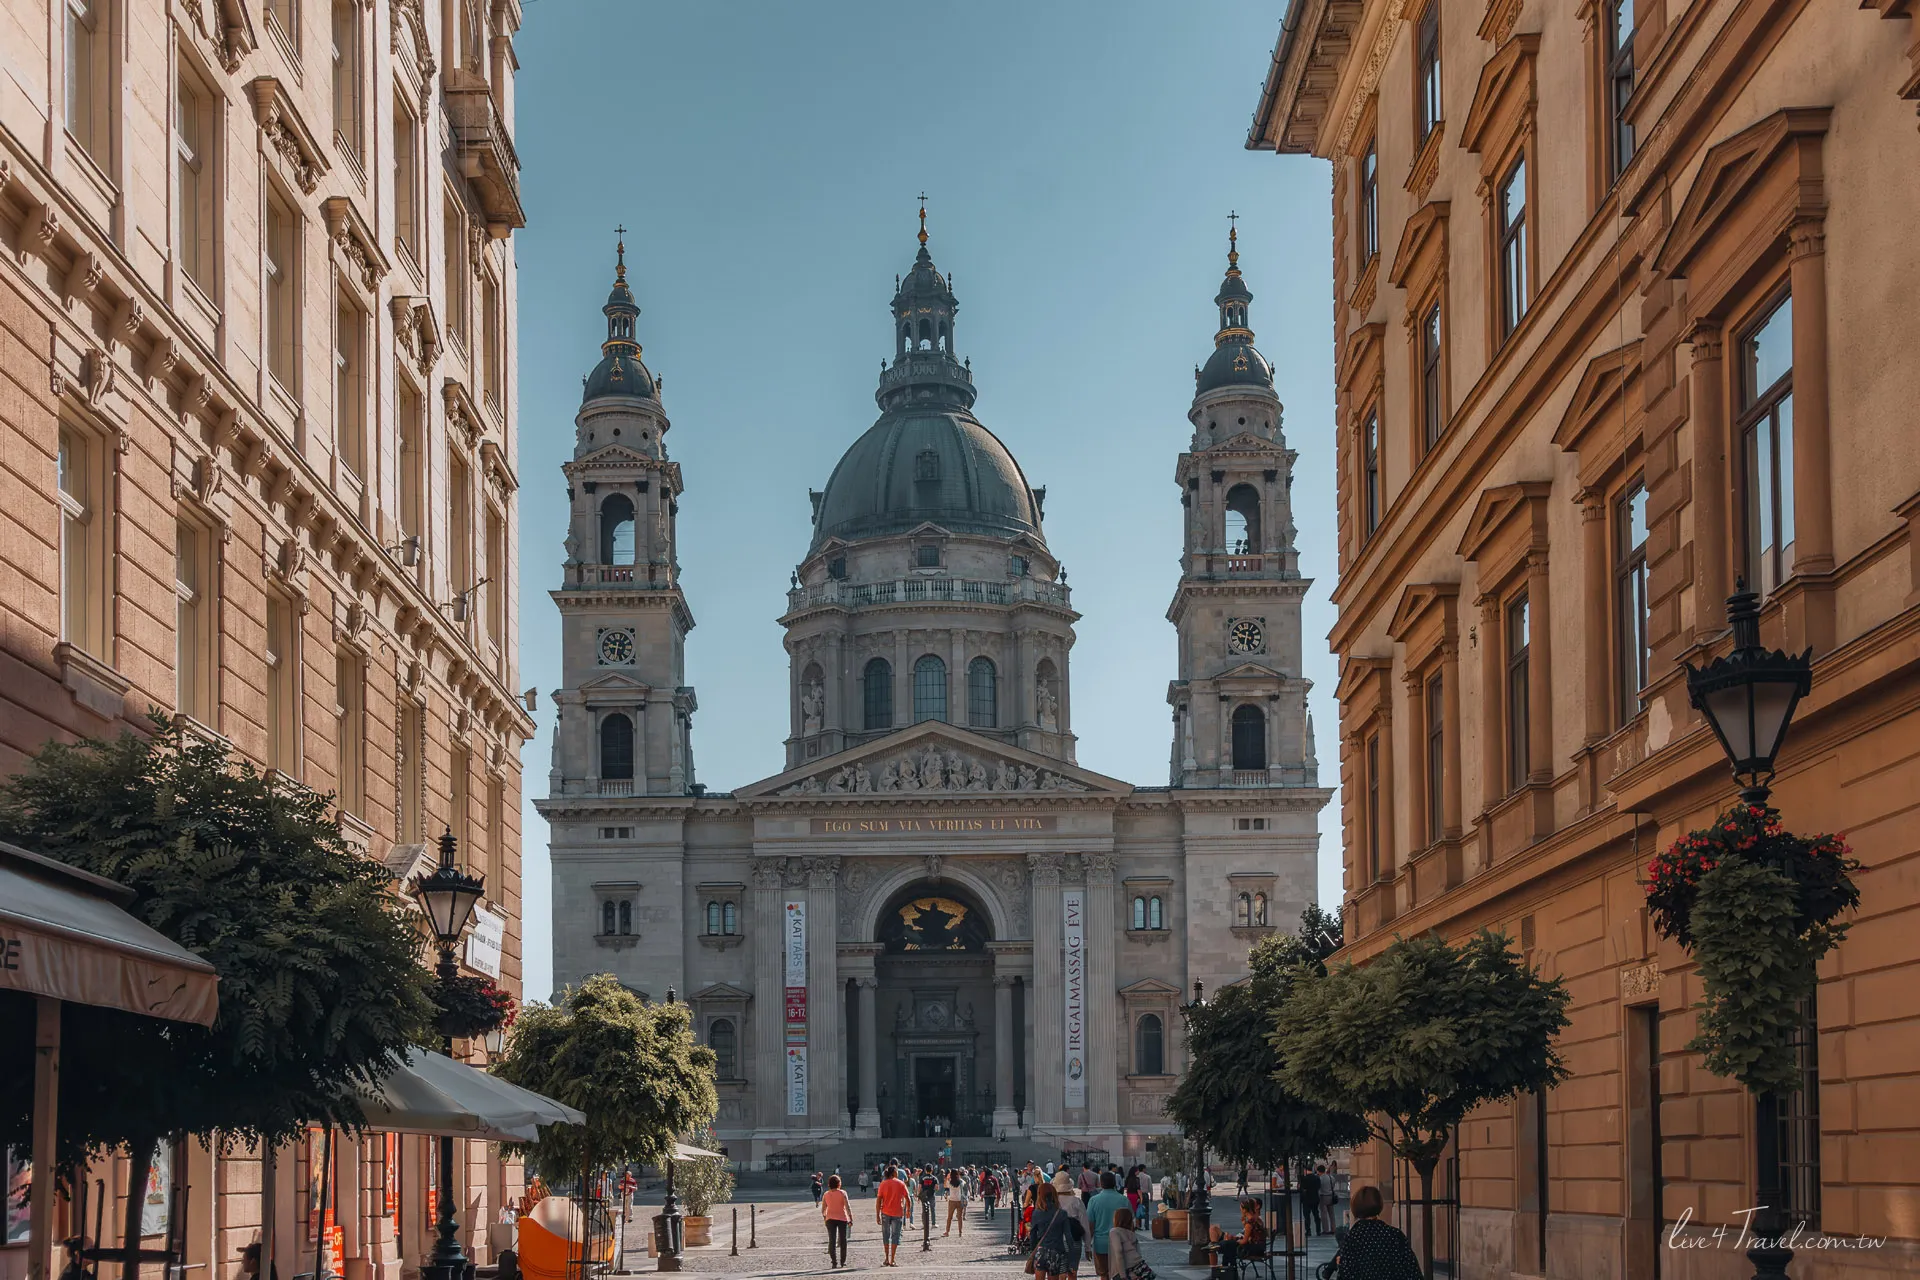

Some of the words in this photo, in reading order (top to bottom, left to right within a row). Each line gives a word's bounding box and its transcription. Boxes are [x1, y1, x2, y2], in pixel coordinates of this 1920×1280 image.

[825, 821, 850, 832] EGO
[860, 821, 889, 832] SUM
[899, 820, 921, 831] VIA
[929, 819, 982, 831] VERITAS
[1014, 818, 1042, 829] VITA
[1065, 899, 1080, 927] ÉVE
[1066, 936, 1081, 1051] IRGALMASSÁG
